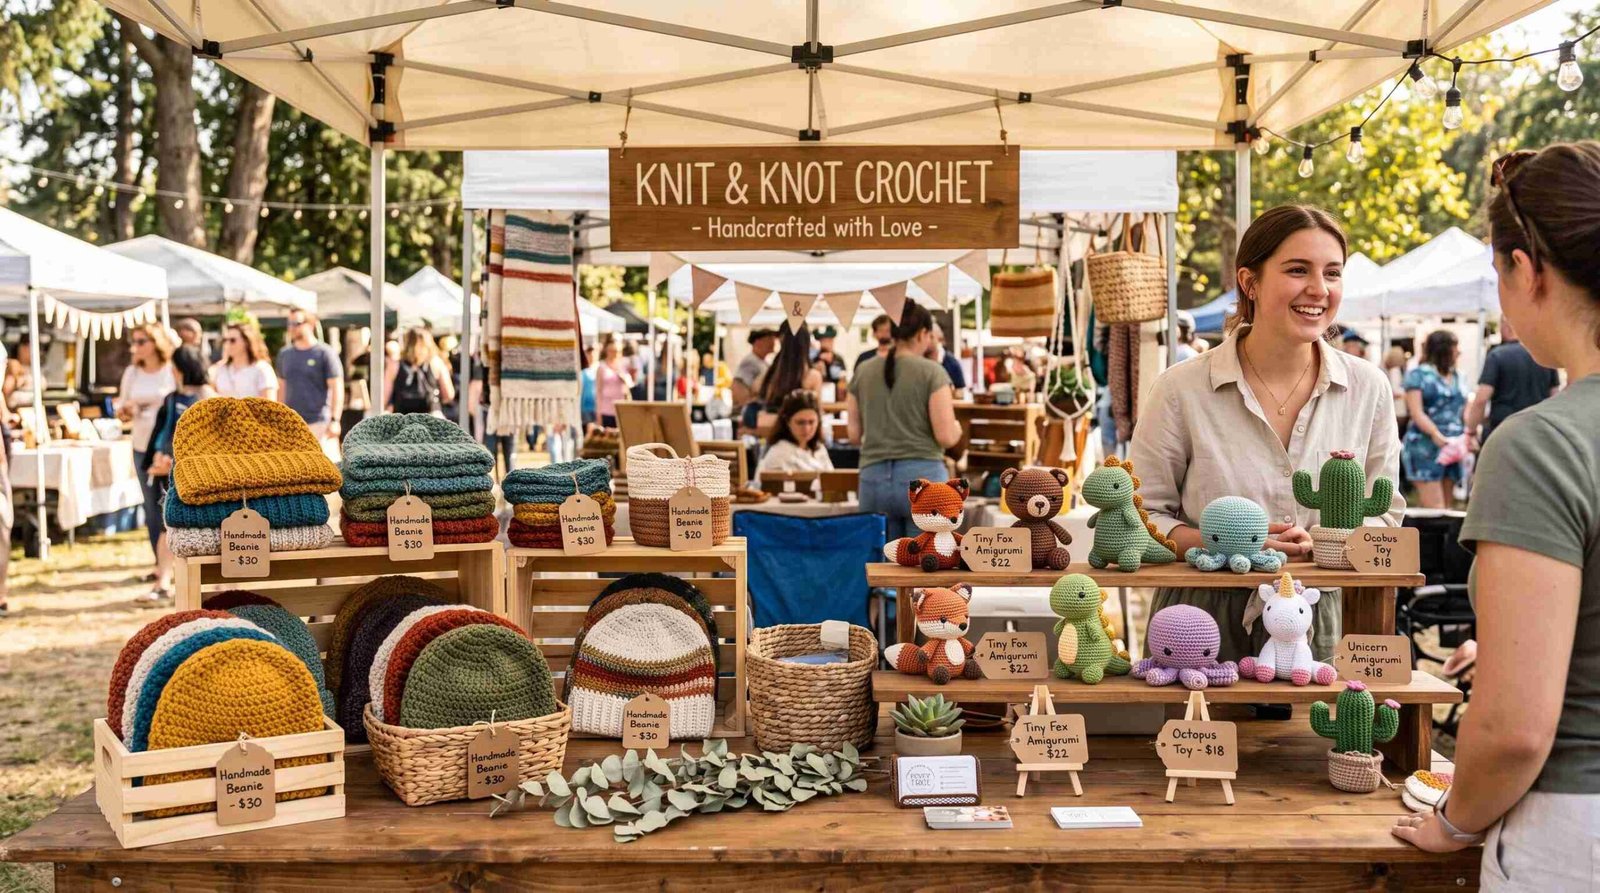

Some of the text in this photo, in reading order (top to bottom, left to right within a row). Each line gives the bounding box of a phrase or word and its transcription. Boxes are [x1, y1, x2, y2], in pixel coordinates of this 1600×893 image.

[636, 160, 993, 206] KNIT & KNOT CROCHET
[708, 216, 826, 238] Handcrafted
[833, 216, 873, 237] with
[880, 216, 922, 237] Love
[792, 301, 803, 317] &
[671, 506, 710, 516] Handmade
[390, 515, 430, 525] Handmade
[561, 512, 600, 523] Handmade
[676, 517, 703, 527] Beanie
[223, 530, 267, 539] Handmade
[394, 527, 423, 536] Beanie
[568, 524, 595, 534] Beanie
[684, 530, 702, 539] $20
[577, 536, 595, 546] $30
[973, 533, 1013, 546] Tiny Fox
[1363, 532, 1398, 543] Ocobus
[229, 541, 260, 551] Beanie
[404, 540, 423, 549] $30
[976, 545, 1023, 558] Amigurumi
[1373, 544, 1392, 557] Toy
[238, 555, 258, 566] $30
[990, 557, 1011, 567] $22
[1373, 556, 1391, 567] $18
[985, 637, 1028, 651] Tiny Fox
[989, 651, 1038, 664] Amigurumi
[1350, 653, 1402, 667] Amigurumi
[1009, 663, 1030, 674] $22
[1364, 666, 1383, 678] $18
[626, 710, 668, 719] Handmade
[630, 719, 660, 729] Beanie
[1023, 722, 1046, 736] Tiny
[639, 731, 658, 740] $30
[1172, 728, 1217, 744] Octopus
[1027, 735, 1079, 749] Amigurumi
[471, 748, 516, 763] Handmade
[1046, 748, 1069, 759] $22
[1173, 743, 1193, 758] Toy
[1205, 744, 1225, 757] $18
[219, 765, 271, 780] Handmade
[476, 763, 509, 774] Beanie
[485, 774, 505, 786] $30
[226, 781, 264, 795] Beanie
[238, 797, 262, 809] $30
